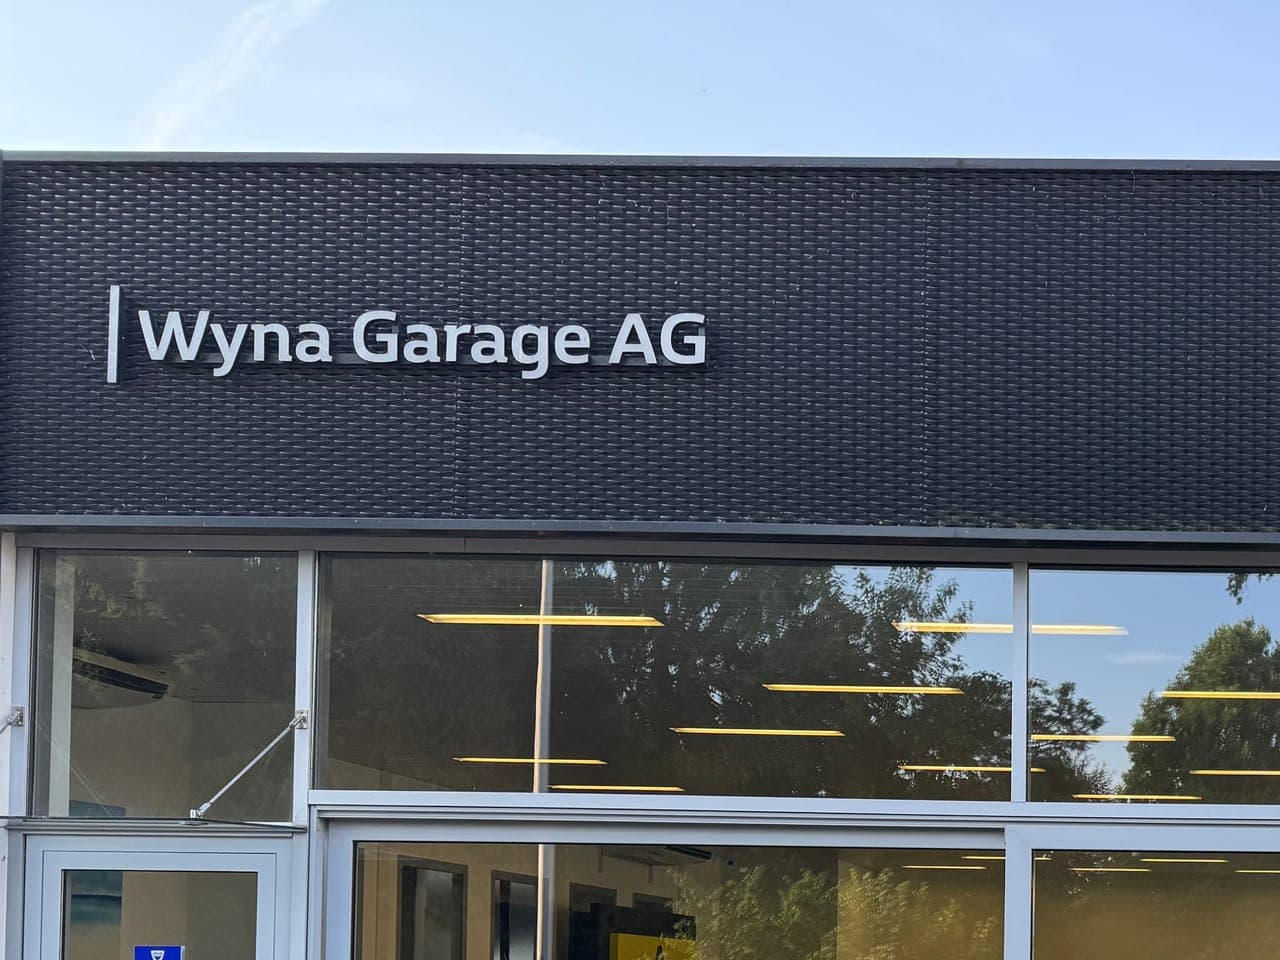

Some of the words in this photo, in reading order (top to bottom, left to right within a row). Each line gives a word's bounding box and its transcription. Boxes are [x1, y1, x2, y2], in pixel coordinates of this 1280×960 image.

[138, 310, 332, 376] Wyna
[353, 310, 591, 379] Garage
[608, 312, 707, 365] AG
